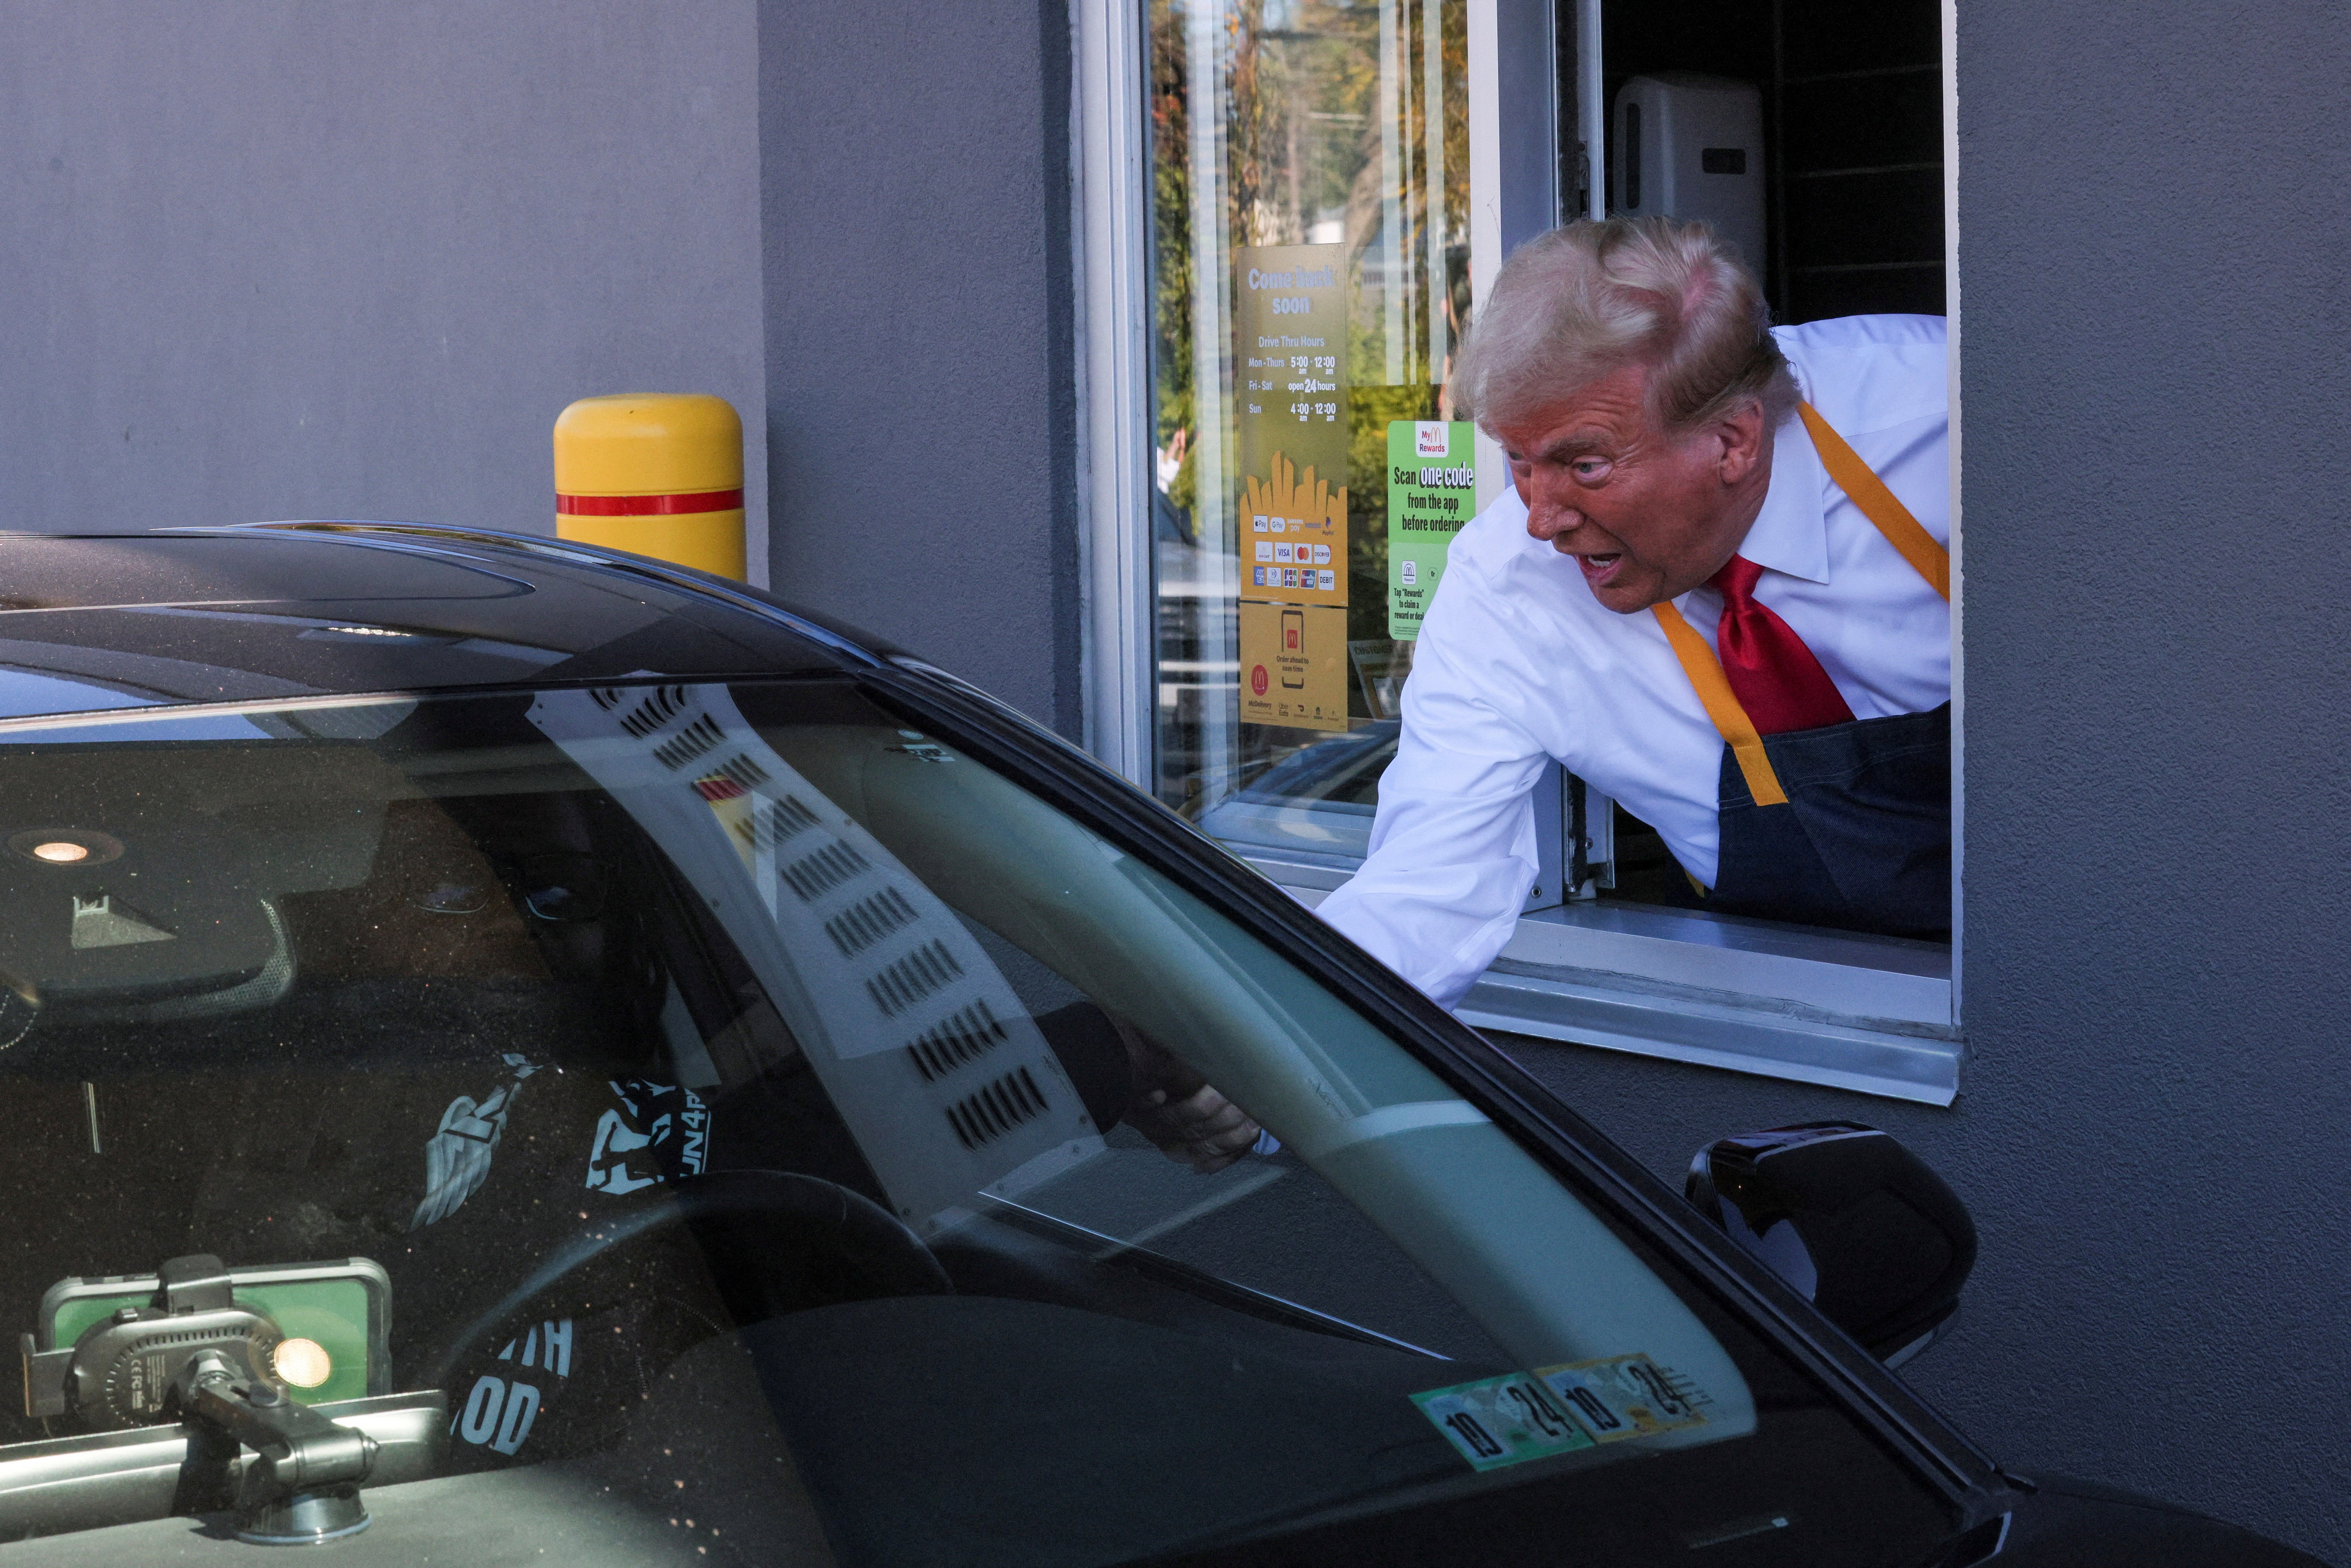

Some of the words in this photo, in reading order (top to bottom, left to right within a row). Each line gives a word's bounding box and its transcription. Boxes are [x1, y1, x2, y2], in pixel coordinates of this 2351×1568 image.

[1249, 268, 1292, 290] Come
[1296, 265, 1334, 288] back
[1273, 297, 1310, 314] soon
[1259, 336, 1279, 347] Drive
[1281, 335, 1299, 347] Thru
[1301, 335, 1325, 347] Hours
[1291, 356, 1308, 368] 5:00
[1314, 356, 1335, 368] 12:00
[1288, 383, 1304, 393] open
[1305, 379, 1317, 393] 24
[1317, 380, 1336, 391] hours
[1249, 403, 1261, 413] Sun
[1315, 403, 1336, 415] 12:00
[1422, 430, 1431, 441] My
[1420, 444, 1445, 452] Rewards
[1394, 467, 1416, 485] Scan
[1419, 466, 1442, 489] one
[1443, 461, 1473, 489] code
[1408, 492, 1426, 508] from
[1428, 493, 1441, 509] the
[1444, 498, 1459, 514] app
[1402, 514, 1428, 531] before
[1278, 548, 1290, 557] VISA
[1404, 600, 1416, 608] claim
[1394, 611, 1409, 619] reward
[1415, 612, 1424, 620] deal
[1248, 700, 1272, 710] McDelivery
[1628, 1363, 1691, 1416] 24
[450, 1375, 540, 1456] OD
[1507, 1382, 1573, 1437] 24
